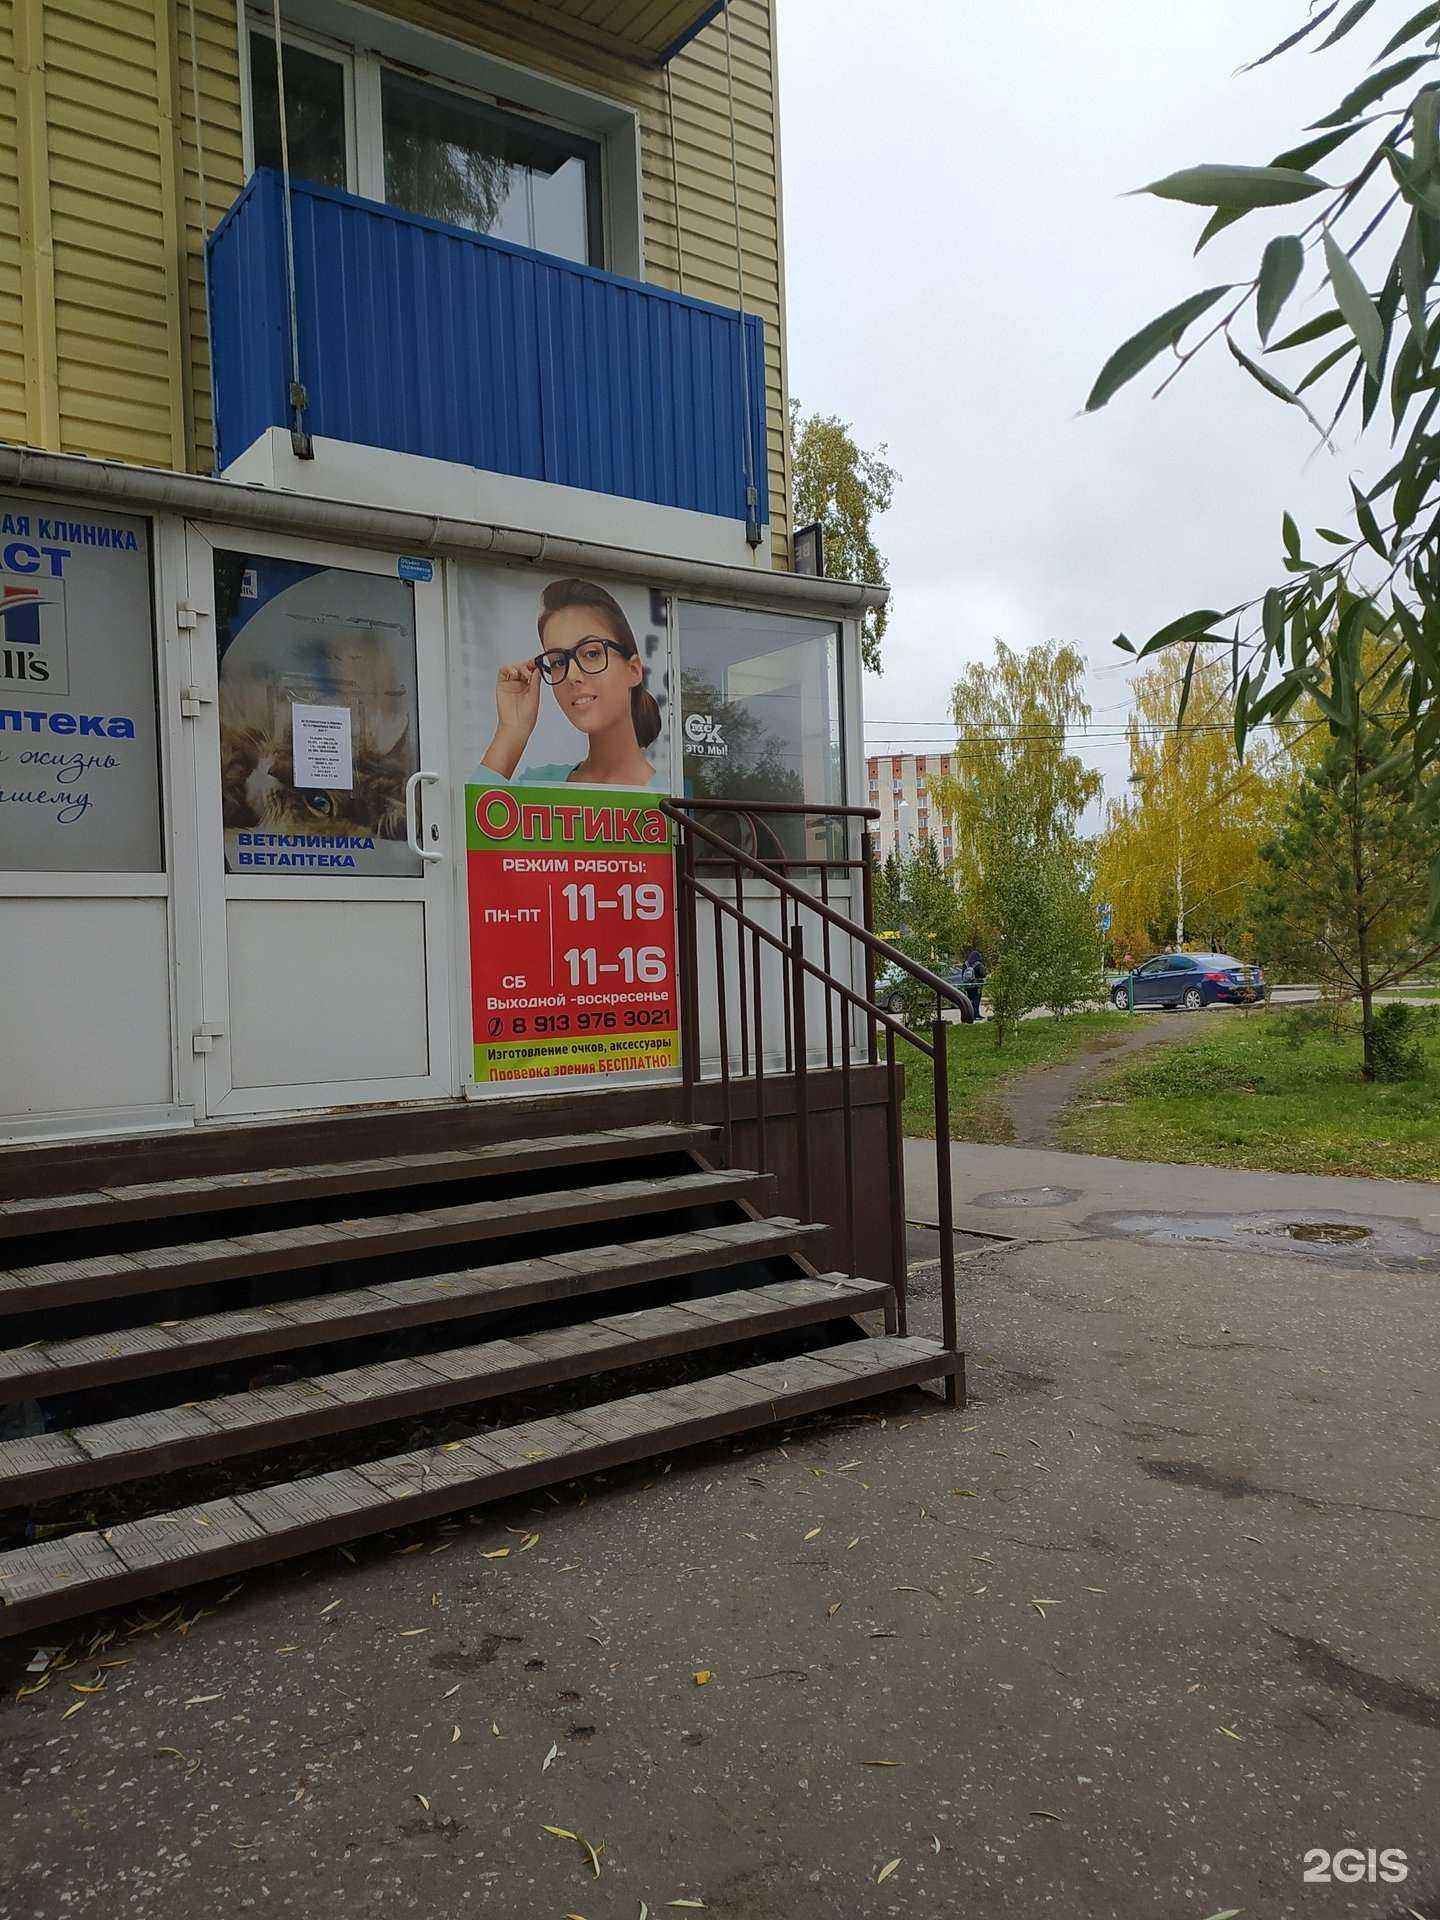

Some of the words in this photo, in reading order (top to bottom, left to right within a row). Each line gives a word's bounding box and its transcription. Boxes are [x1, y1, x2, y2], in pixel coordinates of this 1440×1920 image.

[38, 518, 138, 551] КЛИНИКА
[0, 542, 72, 577] СТ
[0, 650, 50, 682] ll's
[20, 751, 121, 784] жизнь
[0, 787, 93, 823] шему
[475, 789, 669, 844] Оптика
[238, 833, 375, 850] ВЕТКЛИНИКА
[238, 852, 356, 868] ВЕТАПТЕКА
[502, 858, 569, 873] РЕЖИМ
[574, 860, 647, 874] РАБОТЫ:
[562, 883, 665, 922] 11-19
[502, 975, 527, 989] СБ
[563, 946, 667, 986] 11-16
[487, 993, 566, 1011] Выходной
[512, 1017, 527, 1034] 8
[534, 1014, 570, 1032] 913
[577, 1012, 617, 1030] 976
[623, 1009, 671, 1027] 3021
[487, 1045, 569, 1061] Изготовление
[571, 1041, 607, 1054] очков,
[609, 1037, 672, 1053] аксессуары
[489, 1063, 550, 1082] Проверка
[553, 1060, 596, 1077] зрения
[598, 1054, 672, 1073] БЕСПЛАТНО!
